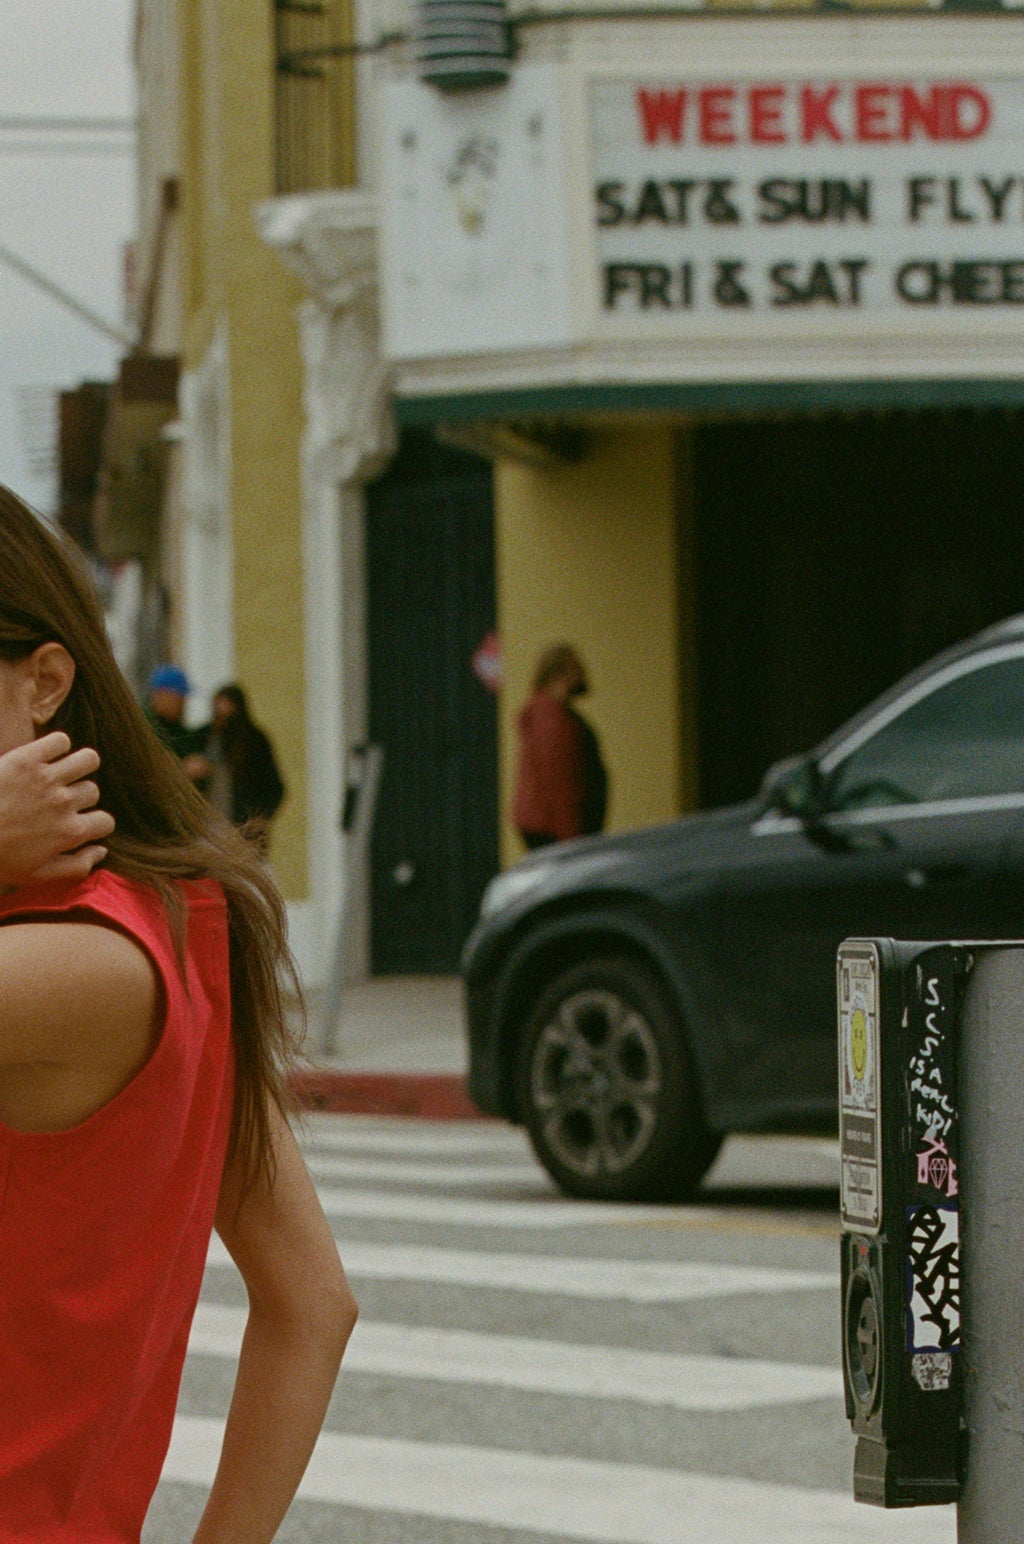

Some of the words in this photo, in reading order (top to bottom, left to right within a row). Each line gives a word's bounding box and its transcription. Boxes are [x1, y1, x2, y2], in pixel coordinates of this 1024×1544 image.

[636, 84, 993, 145] WEEKEND
[756, 176, 872, 225] SUN
[906, 175, 1024, 224] FLY
[602, 258, 694, 310] FRI
[714, 258, 751, 307] &
[769, 256, 870, 307] SAT
[928, 1067, 943, 1085] A
